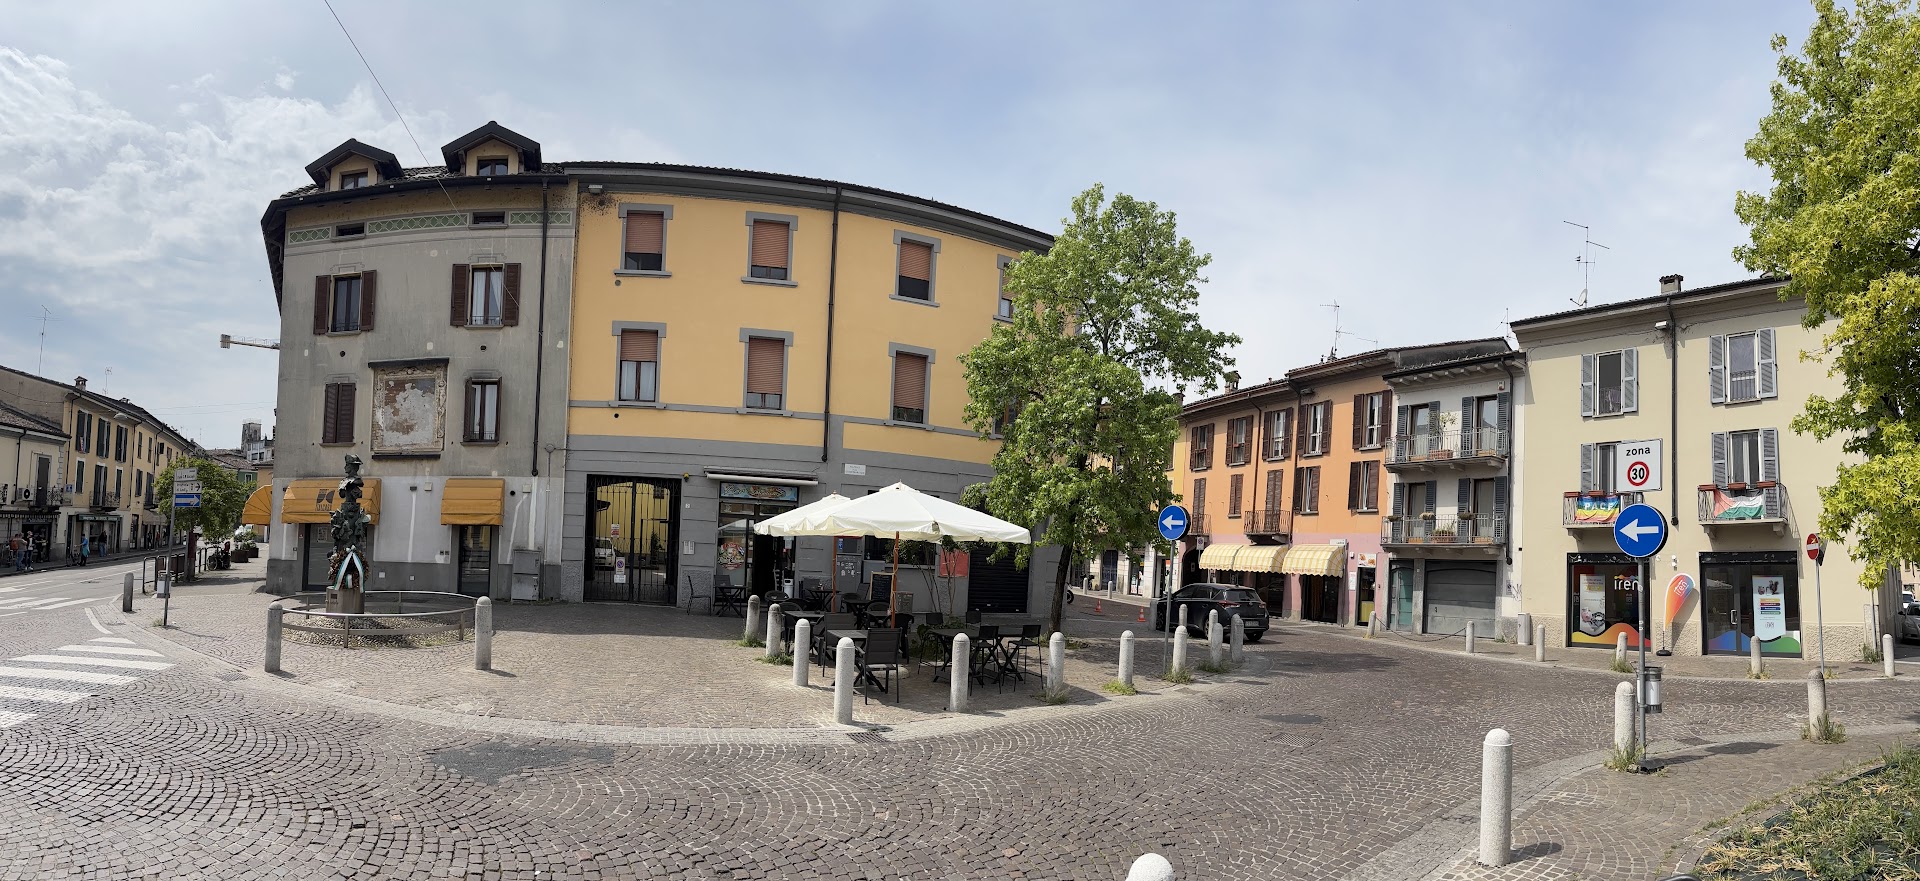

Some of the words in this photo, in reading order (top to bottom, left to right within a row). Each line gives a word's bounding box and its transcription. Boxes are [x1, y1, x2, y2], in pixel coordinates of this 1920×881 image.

[1626, 446, 1651, 457] zona
[1631, 467, 1645, 480] 30
[1614, 579, 1639, 591] iren
[1674, 580, 1688, 597] iren
